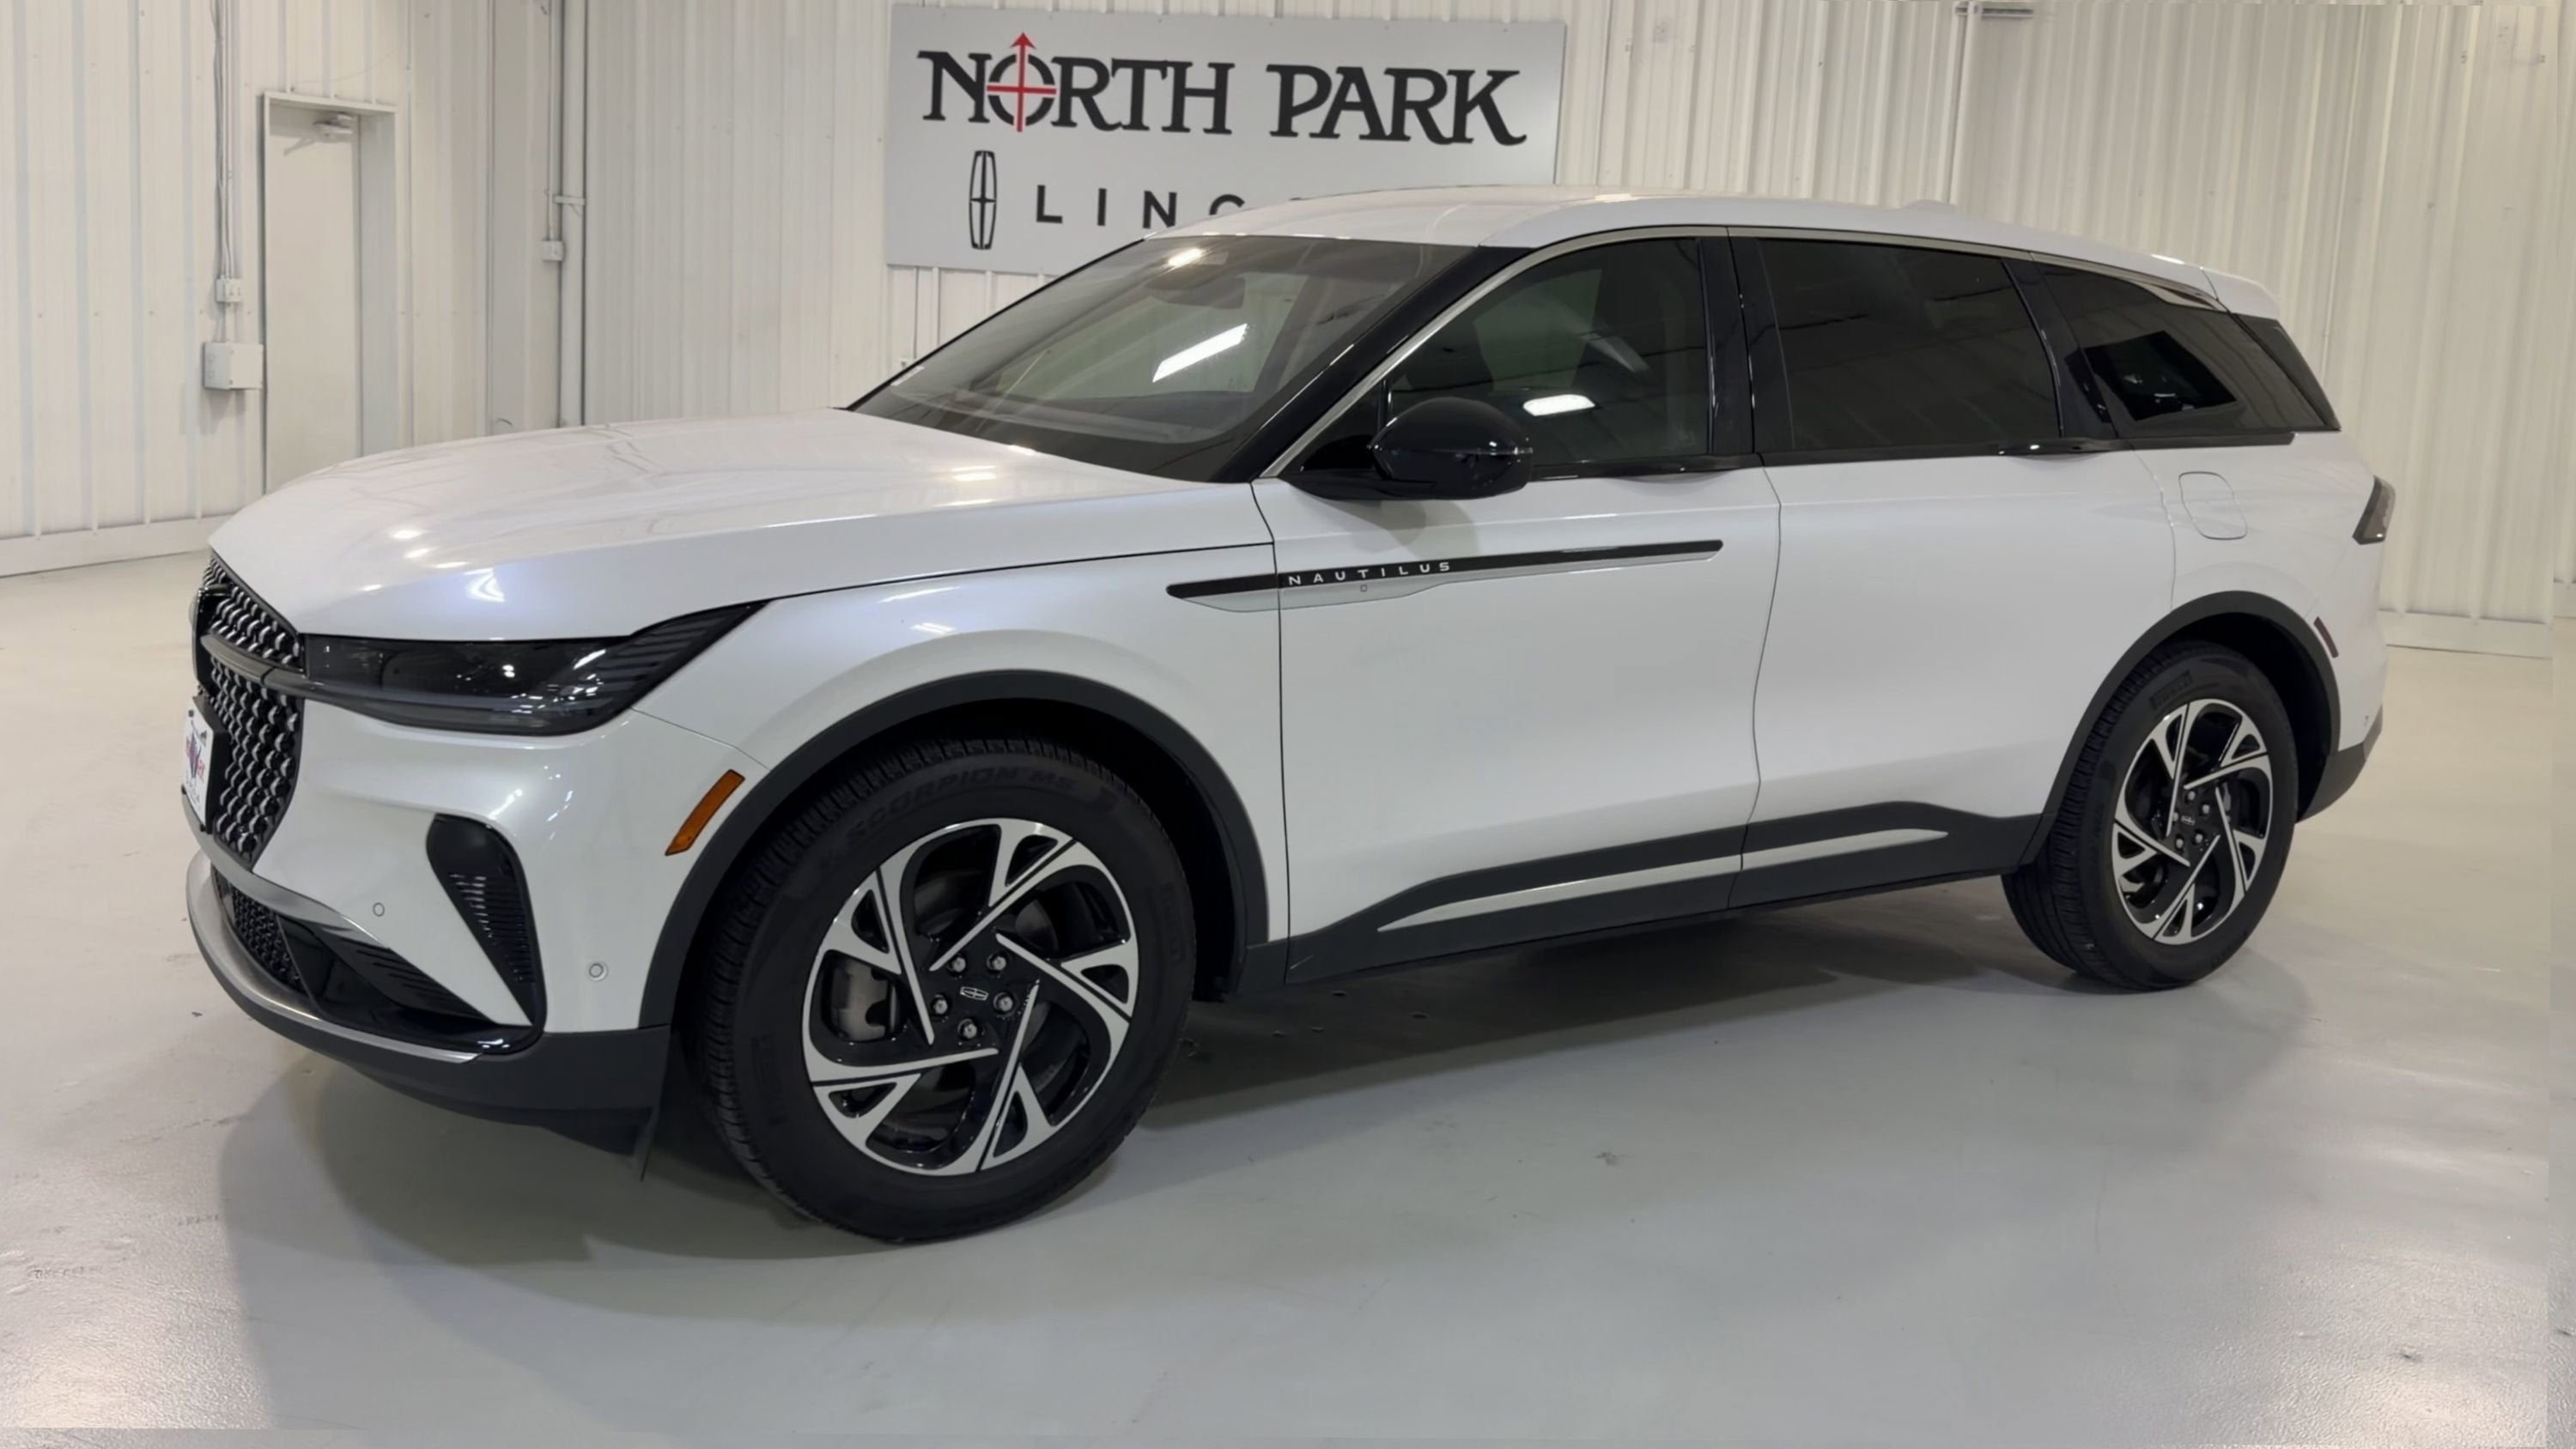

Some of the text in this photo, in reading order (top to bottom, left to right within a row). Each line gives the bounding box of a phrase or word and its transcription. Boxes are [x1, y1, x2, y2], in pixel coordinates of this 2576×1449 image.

[916, 49, 1528, 146] NORTH PARK
[1288, 561, 1450, 586] NAUTILUS
[845, 766, 1020, 841] SCORPION
